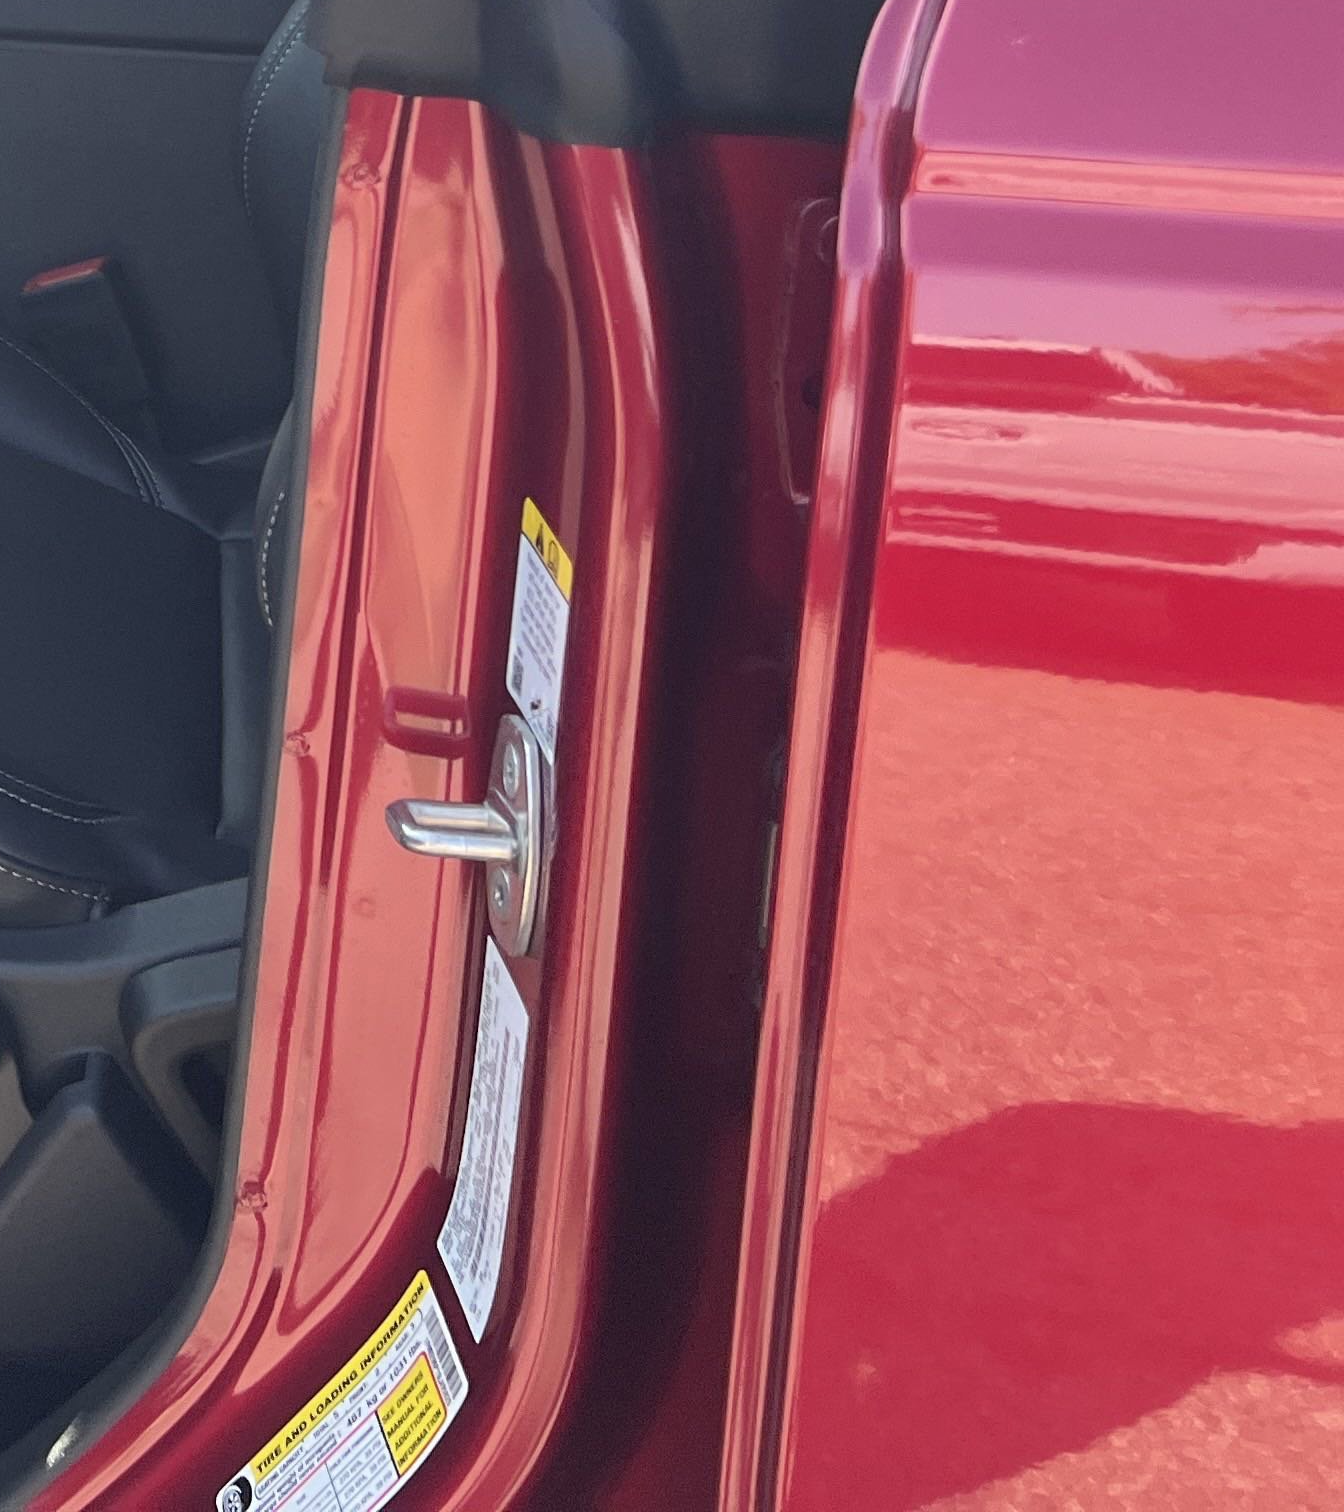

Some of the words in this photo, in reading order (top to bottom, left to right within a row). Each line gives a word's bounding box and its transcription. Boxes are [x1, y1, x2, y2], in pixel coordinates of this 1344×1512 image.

[256, 1445, 282, 1473] TIRE
[285, 1421, 308, 1449] AND
[310, 1370, 358, 1422] LOADING
[360, 1282, 424, 1371] INFORMATION
[387, 1404, 415, 1439] MANUAL
[415, 1383, 430, 1405] FOR
[395, 1400, 434, 1451] ADDITIONAL
[398, 1408, 442, 1467] INFORMATION
